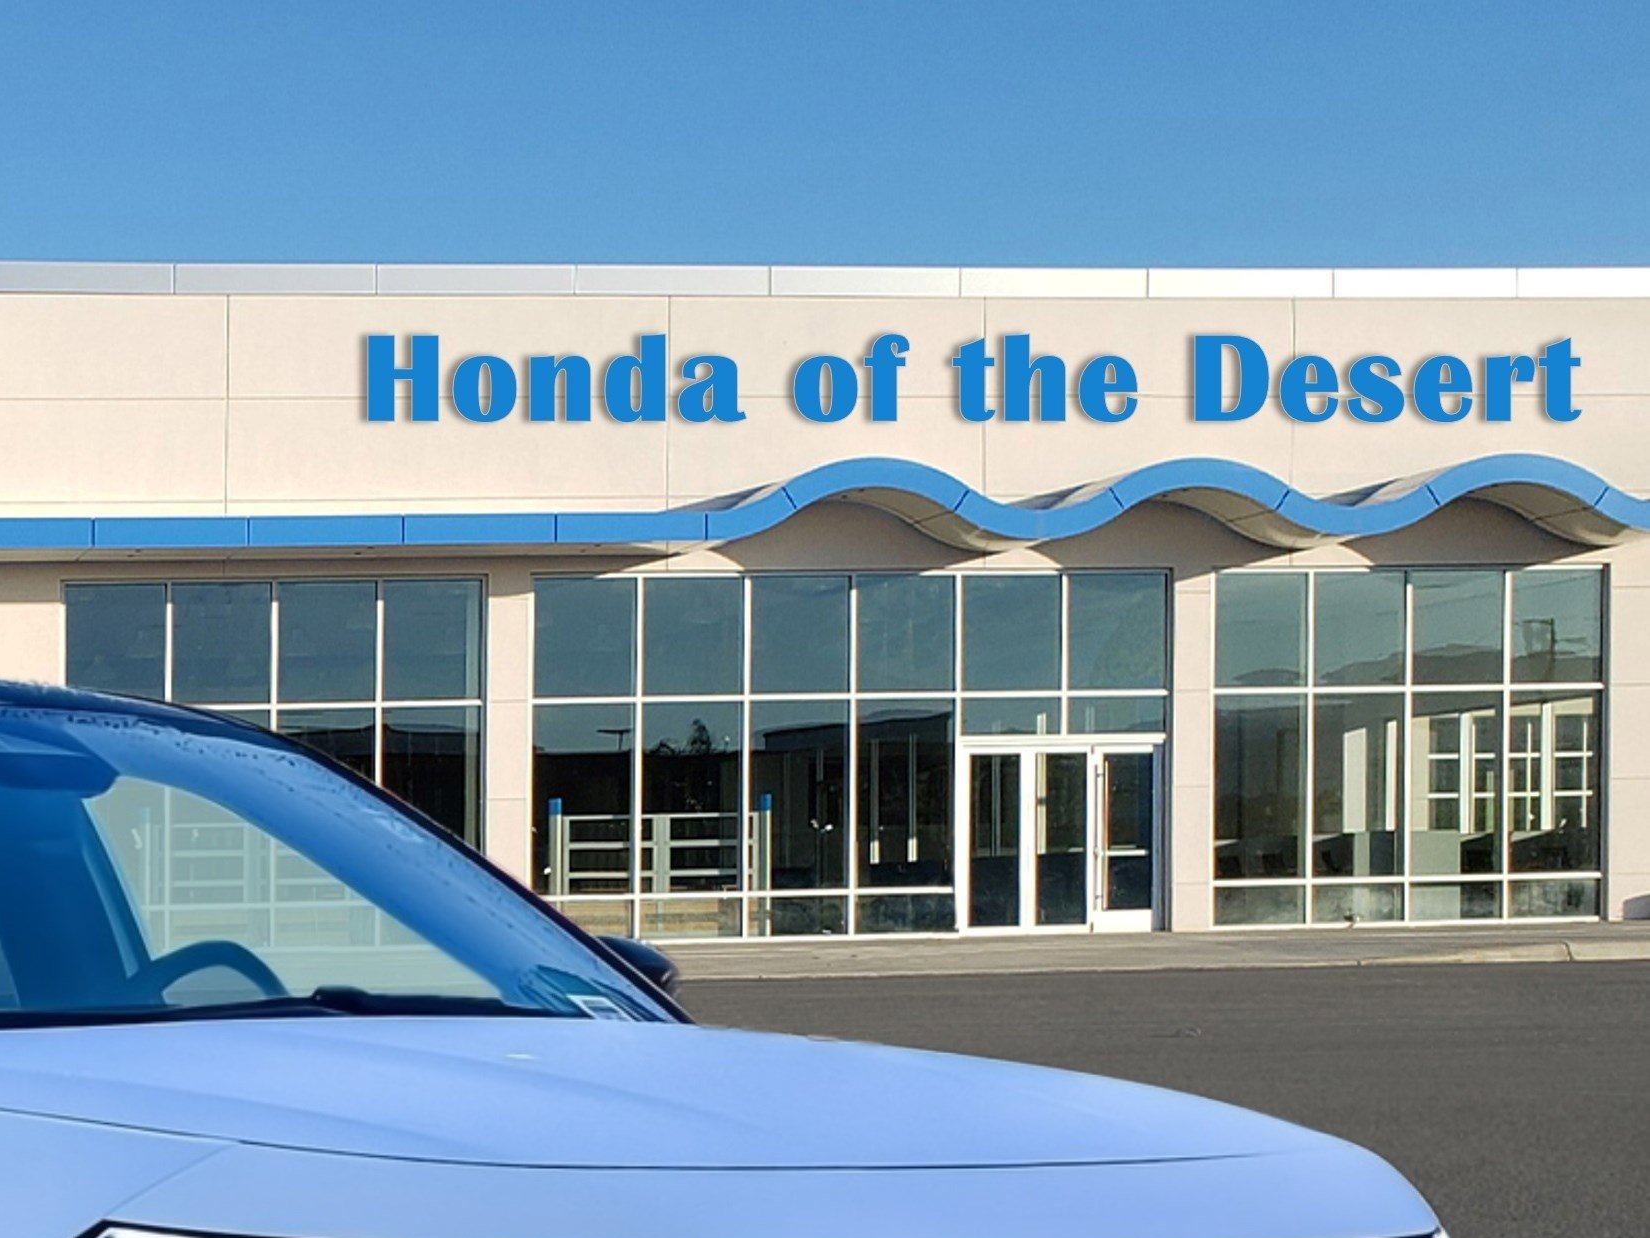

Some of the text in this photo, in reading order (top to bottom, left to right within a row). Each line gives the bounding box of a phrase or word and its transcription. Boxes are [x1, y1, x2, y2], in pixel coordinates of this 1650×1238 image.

[366, 333, 1583, 424] Honda of the Desert
